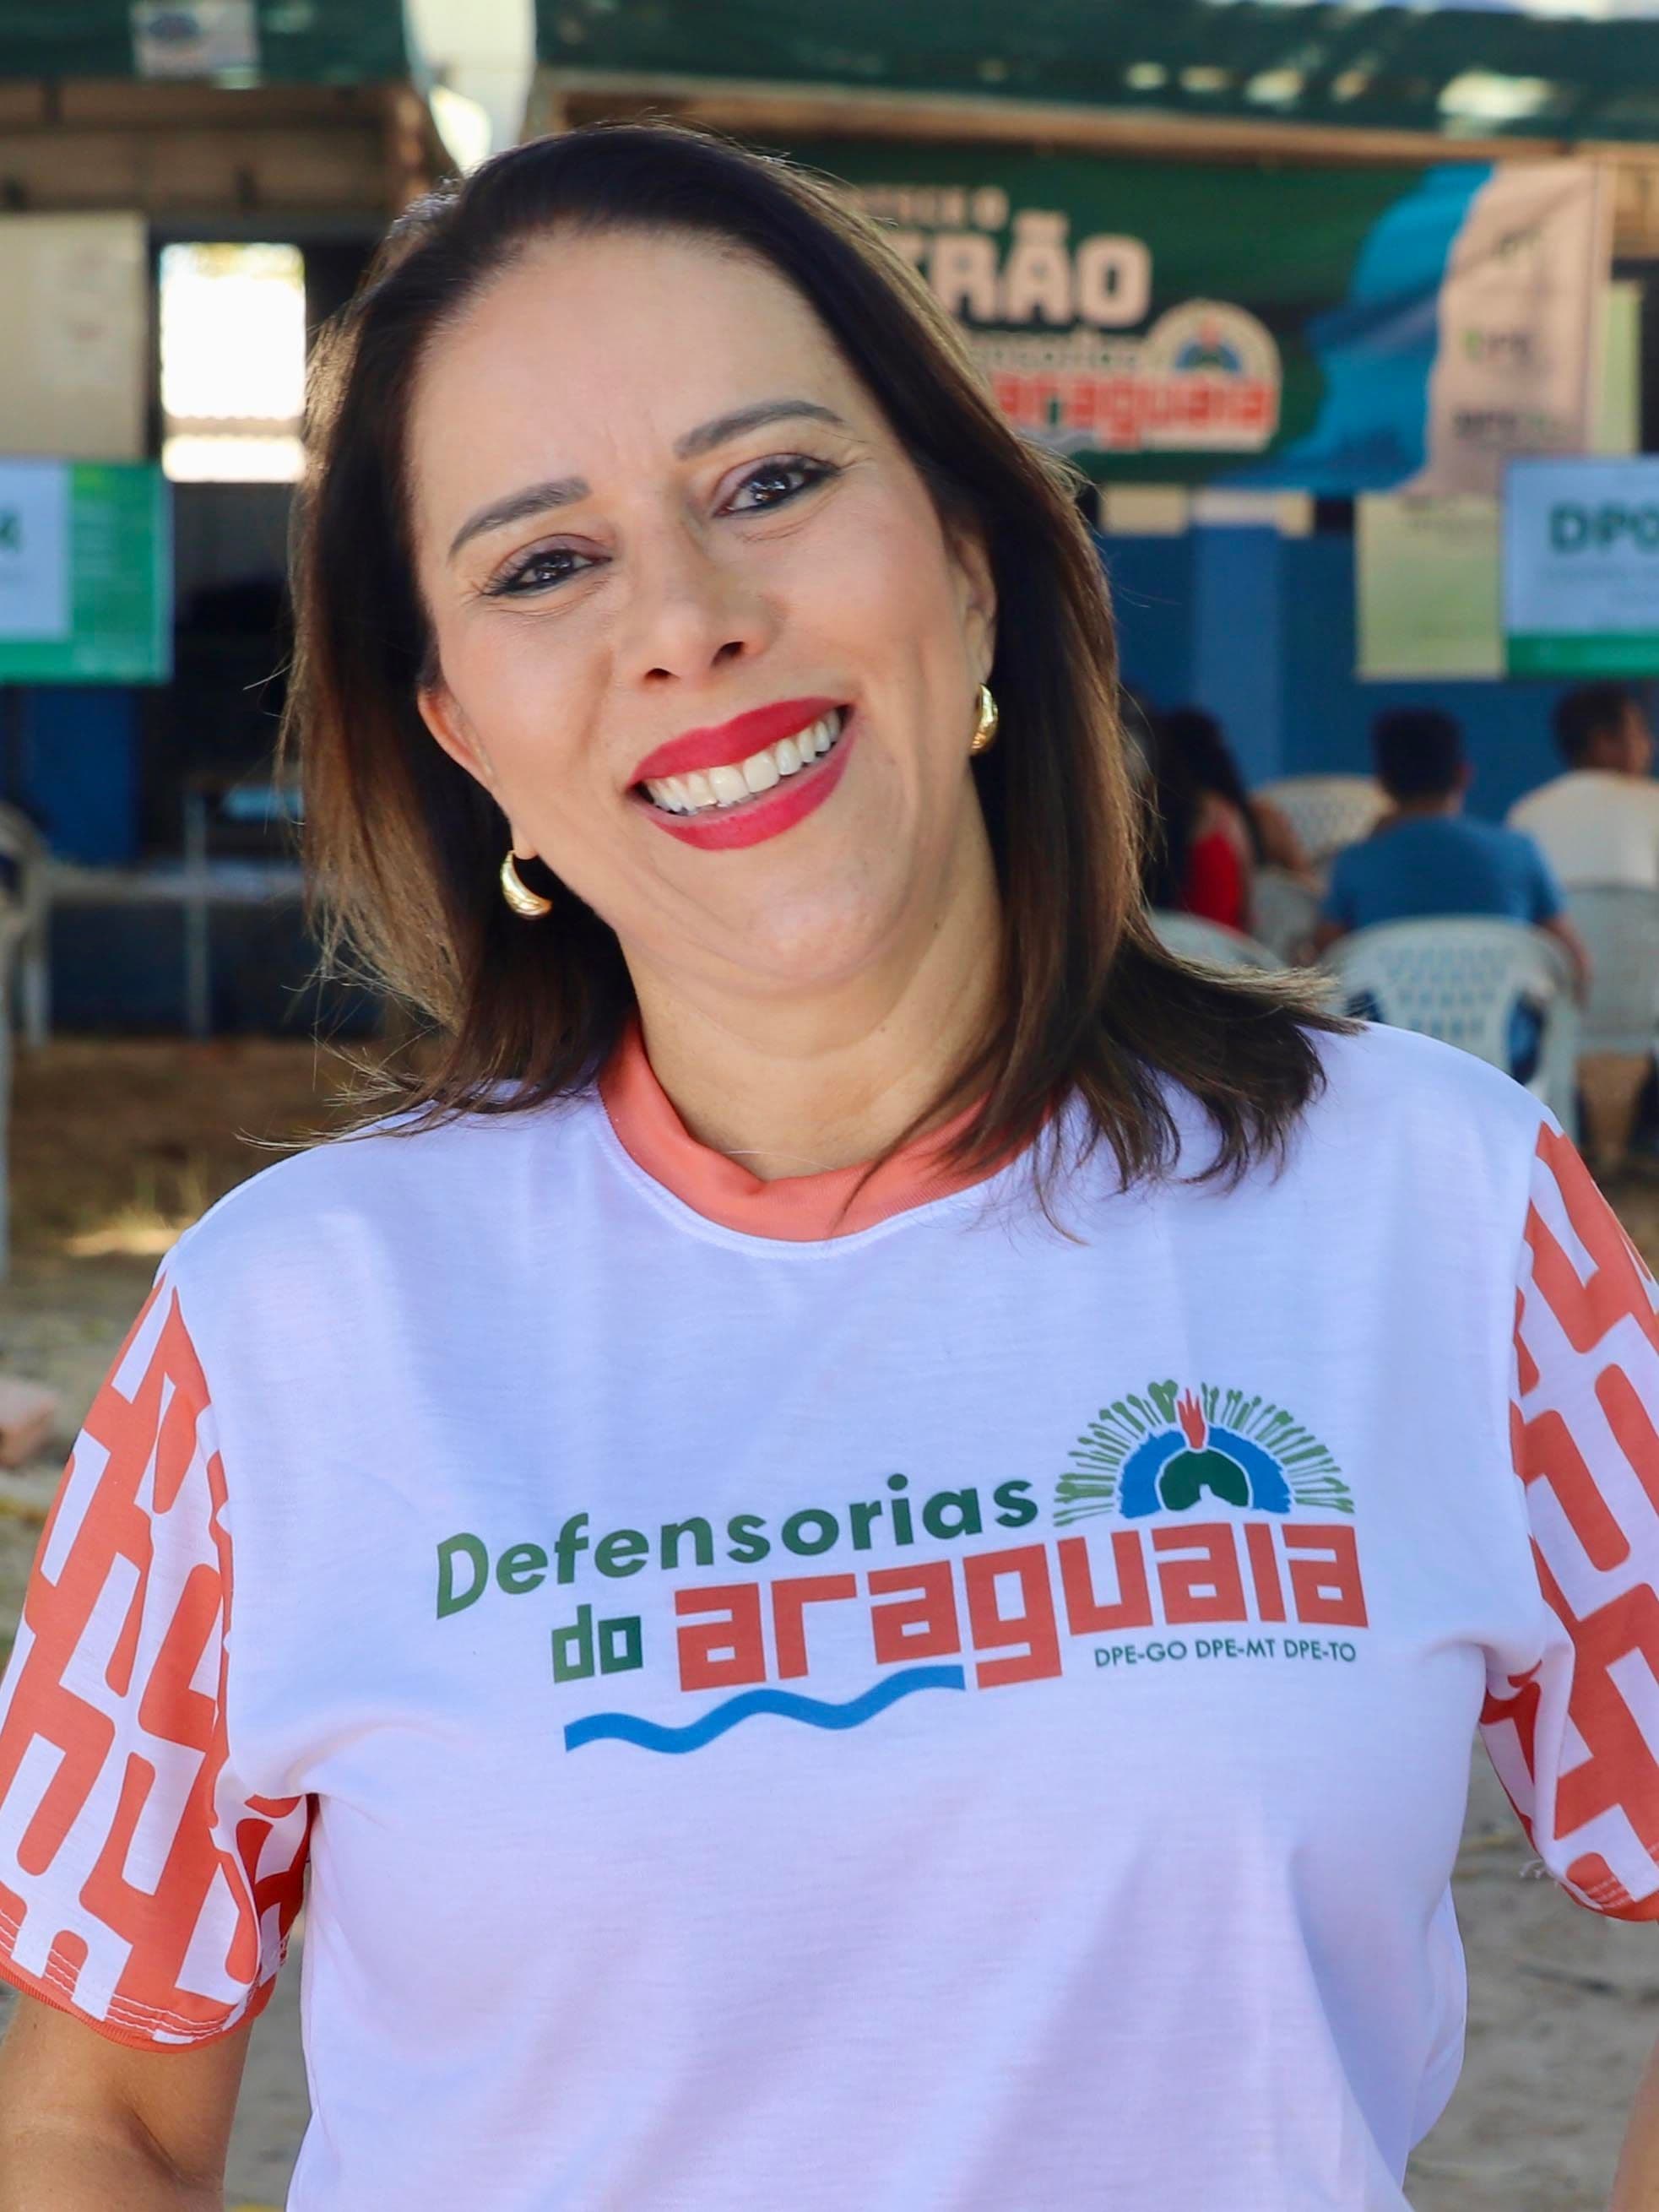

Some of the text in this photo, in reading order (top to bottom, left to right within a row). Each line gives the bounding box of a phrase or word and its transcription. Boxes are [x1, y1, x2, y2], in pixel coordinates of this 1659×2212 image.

[436, 1473, 1038, 1619] Defensorias
[551, 1522, 1369, 1692] do araguaia
[1094, 1638, 1357, 1667] DPE-GO DPE-MT DPE-TO
